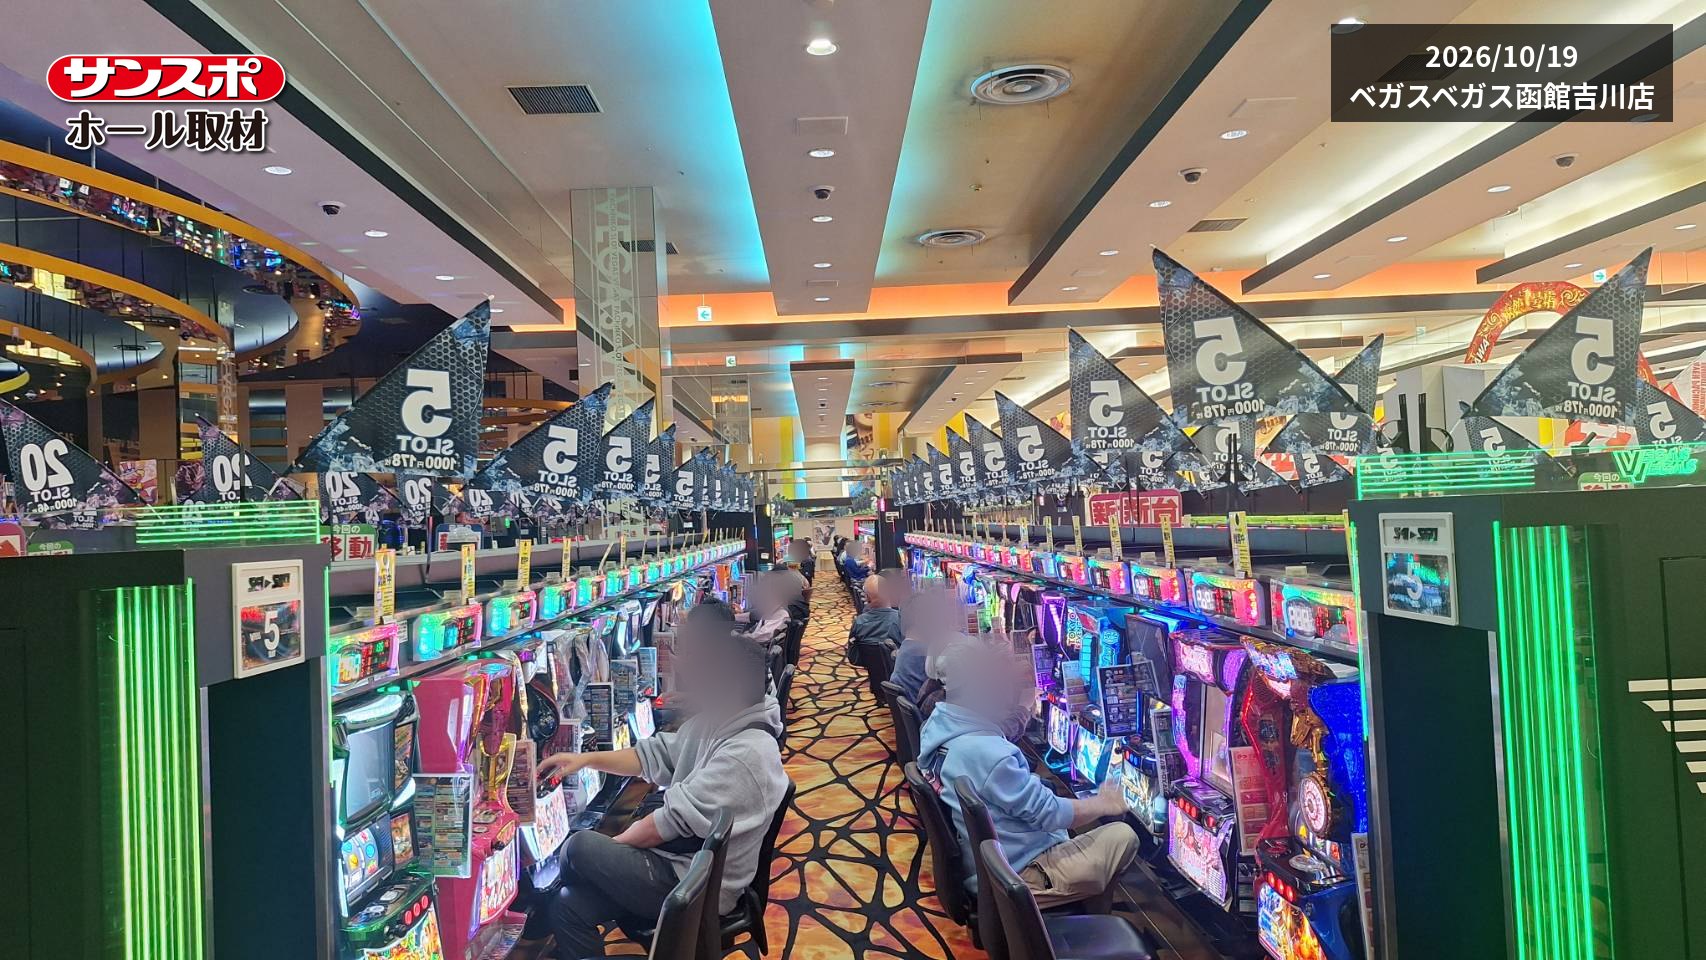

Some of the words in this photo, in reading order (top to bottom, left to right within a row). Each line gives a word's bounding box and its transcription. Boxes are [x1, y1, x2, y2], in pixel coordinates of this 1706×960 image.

[1594, 473, 1620, 482] 今回の
[332, 526, 361, 534] 今回の
[264, 610, 280, 651] 5
